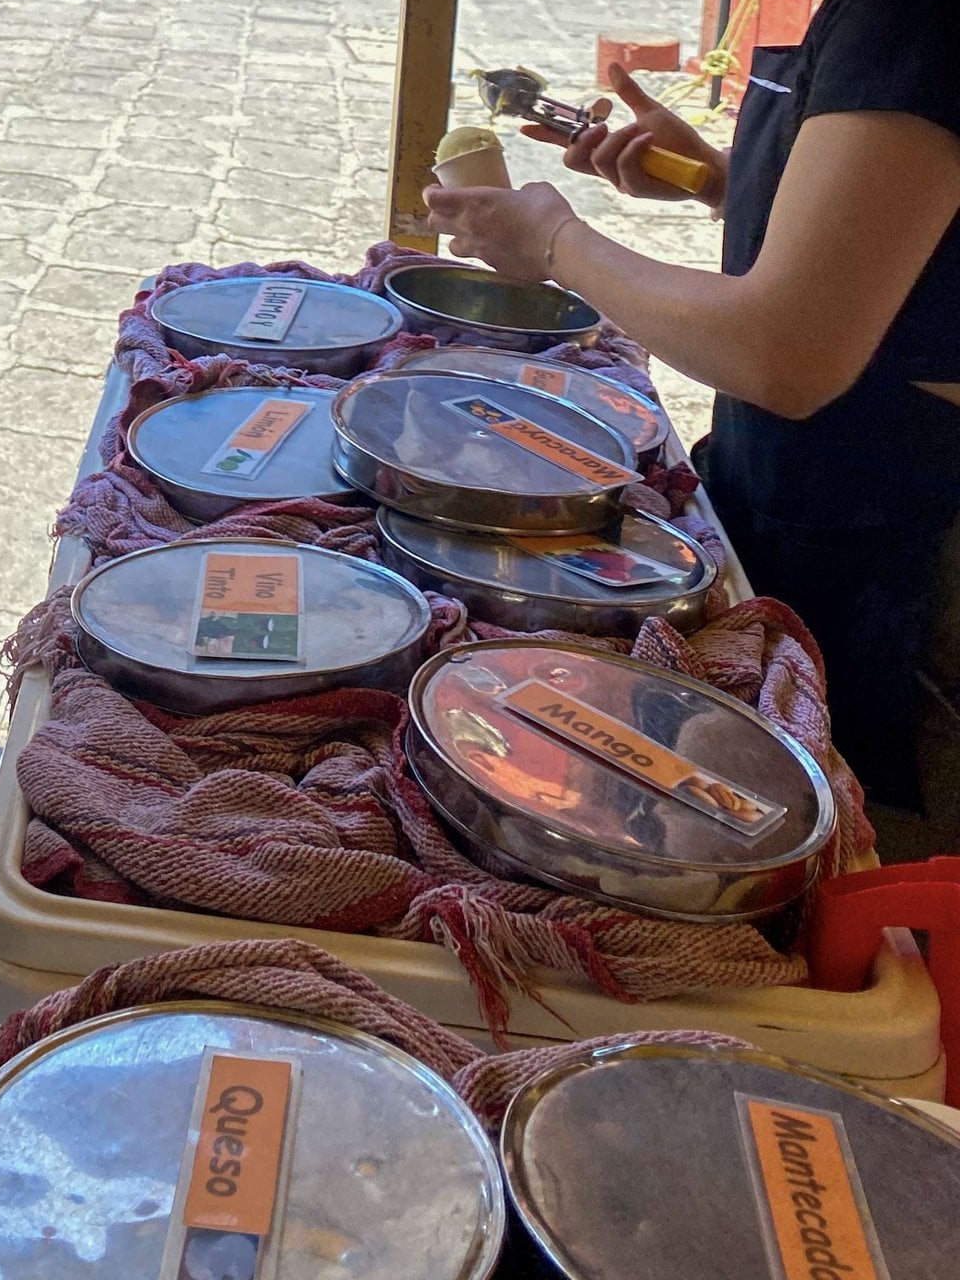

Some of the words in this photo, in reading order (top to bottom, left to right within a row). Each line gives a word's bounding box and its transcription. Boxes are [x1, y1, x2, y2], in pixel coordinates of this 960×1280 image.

[248, 286, 303, 327] CHAMOY
[238, 410, 288, 438] Limón
[503, 421, 624, 479] Maracuyá
[206, 567, 236, 599] Tinto
[255, 572, 283, 599] Vino
[539, 702, 654, 768] Mango
[205, 1085, 264, 1197] Queso
